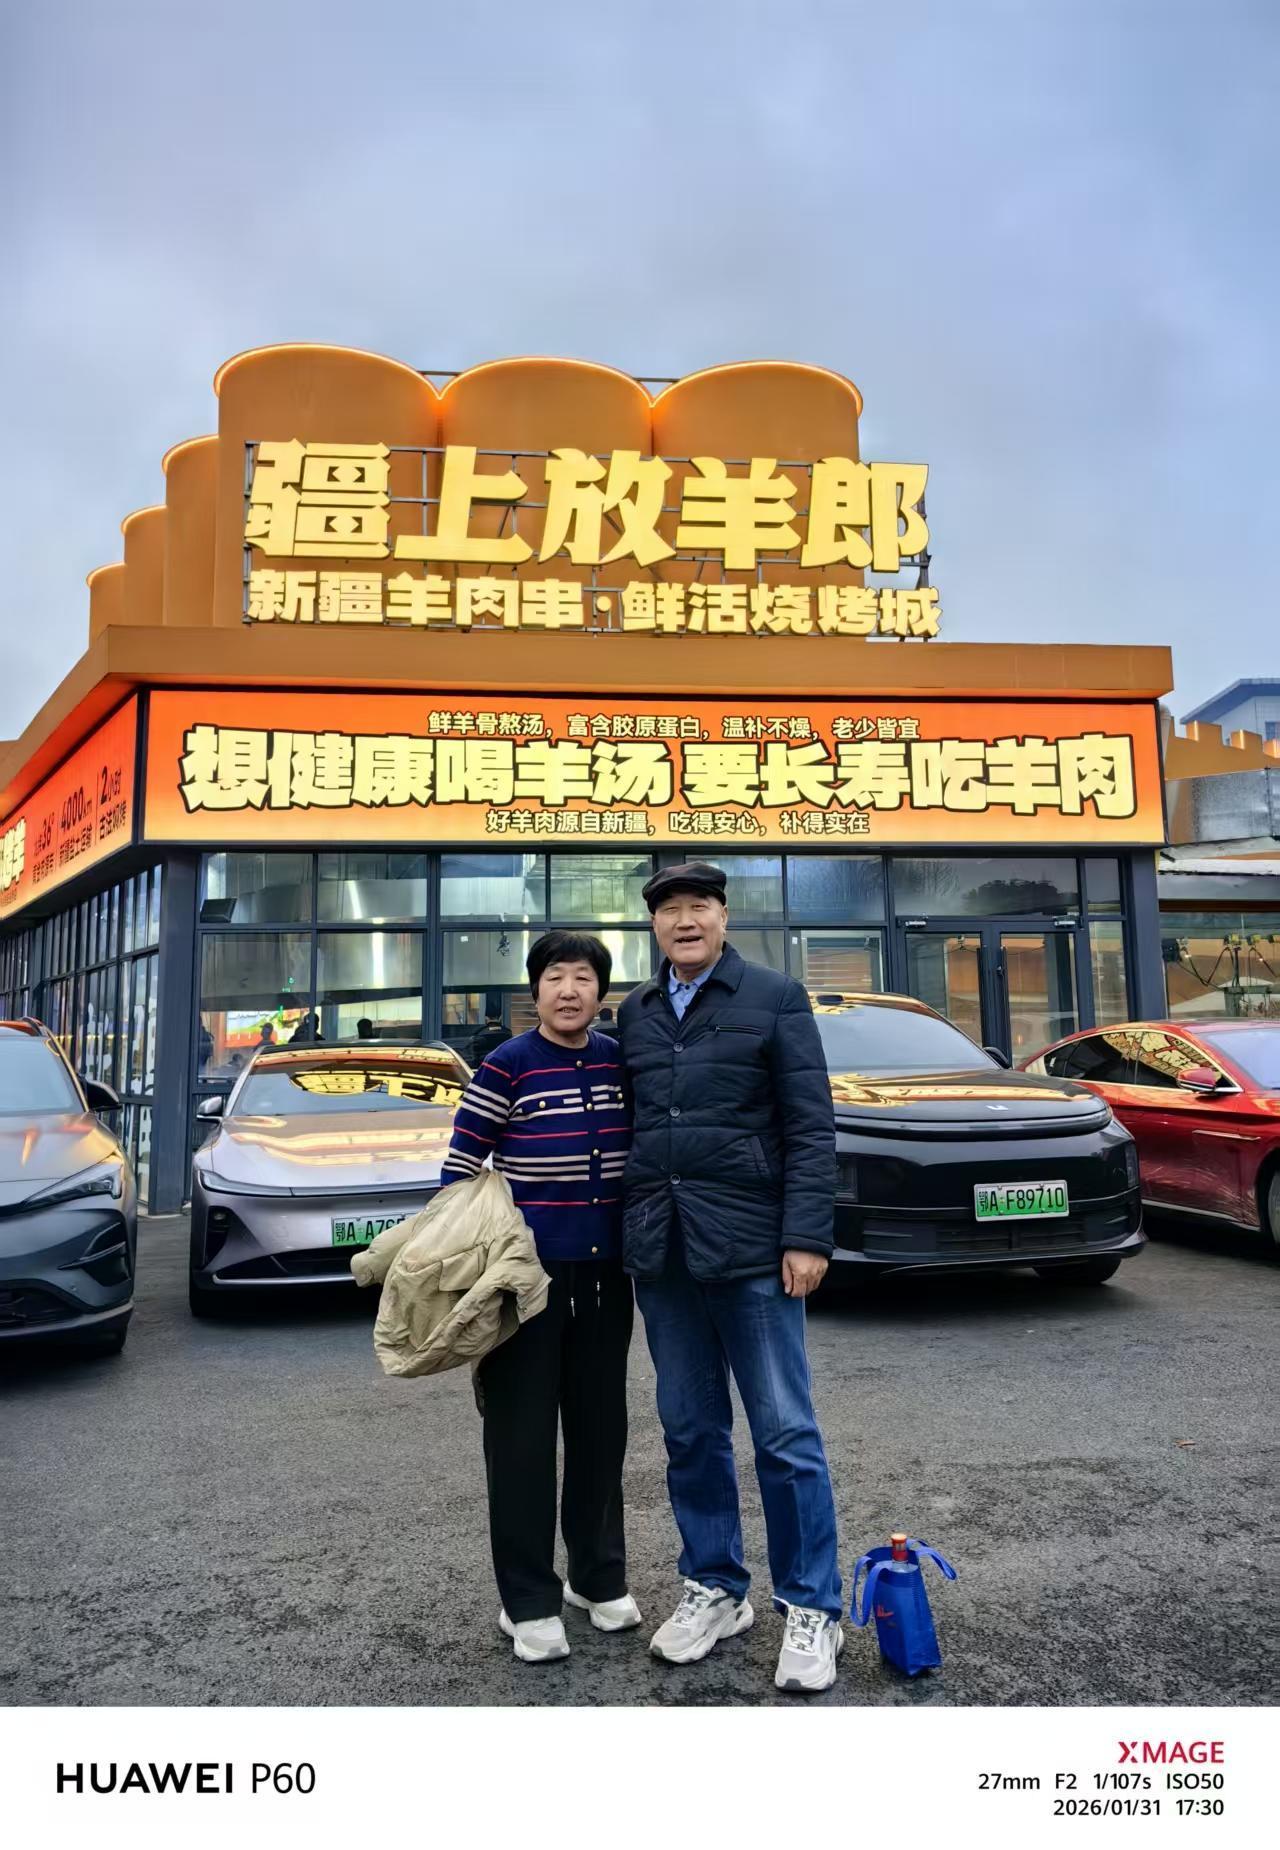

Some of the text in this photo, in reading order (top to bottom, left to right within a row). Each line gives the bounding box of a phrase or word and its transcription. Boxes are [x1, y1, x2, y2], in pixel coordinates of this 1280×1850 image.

[244, 438, 930, 573] 疆上放羊郎
[248, 570, 943, 638] 新疆羊肉串·鲜活烧烤城
[179, 723, 1138, 818] 想健康喝羊汤 要长寿吃羊肉
